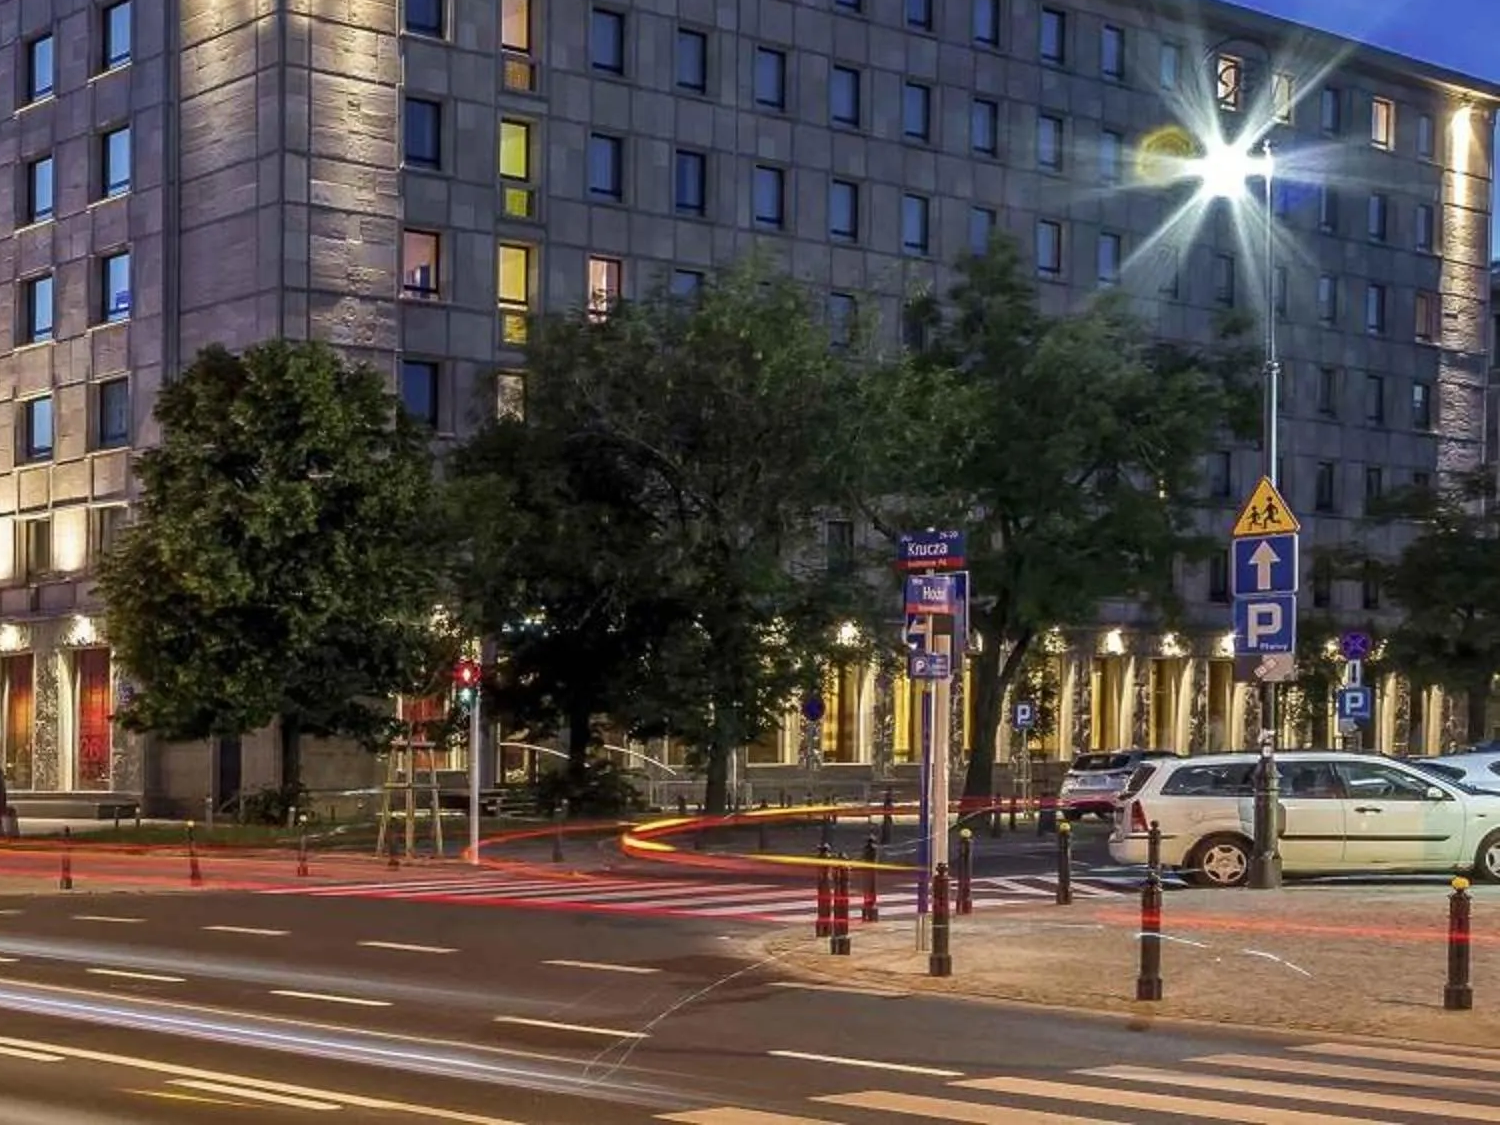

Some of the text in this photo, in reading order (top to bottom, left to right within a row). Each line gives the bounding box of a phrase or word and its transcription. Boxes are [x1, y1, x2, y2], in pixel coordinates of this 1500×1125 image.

[907, 542, 949, 556] Krucza
[1247, 602, 1283, 648] P
[1017, 704, 1031, 724] P
[1345, 692, 1364, 715] P
